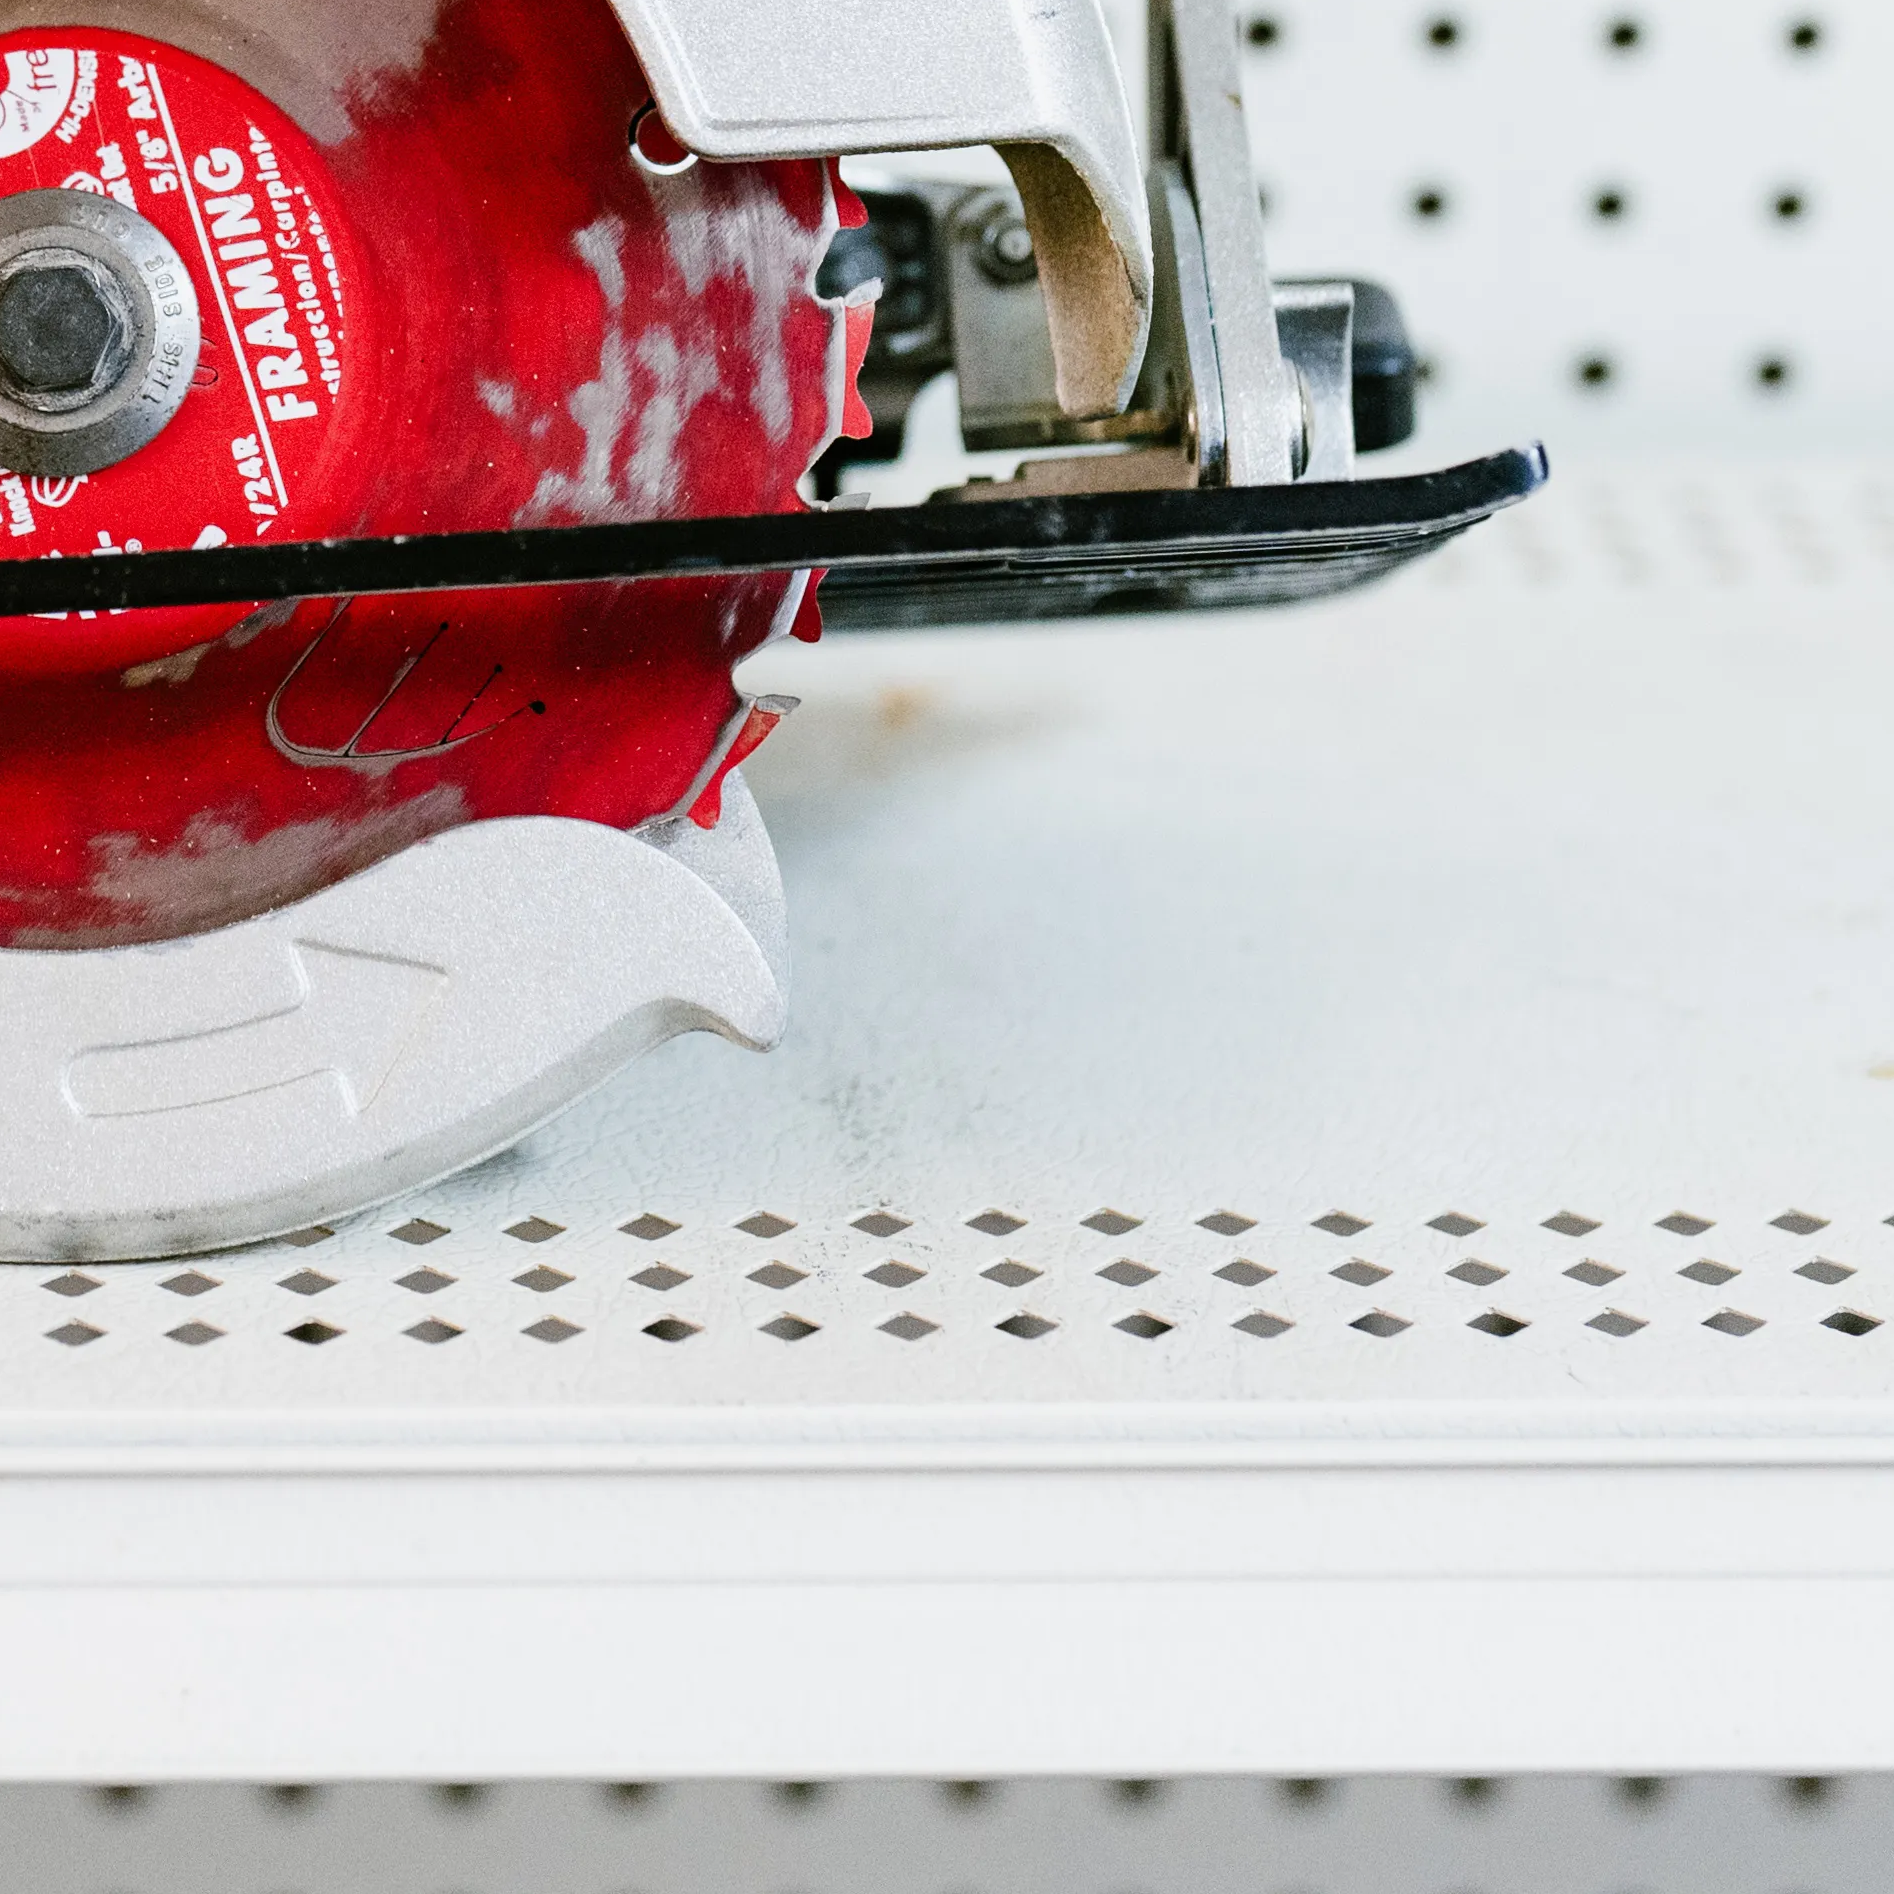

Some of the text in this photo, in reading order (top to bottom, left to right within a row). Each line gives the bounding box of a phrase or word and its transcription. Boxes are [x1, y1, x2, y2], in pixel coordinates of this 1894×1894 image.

[118, 55, 157, 119] Arb
[144, 254, 182, 318] SIDE
[194, 147, 318, 422] FRAMING
